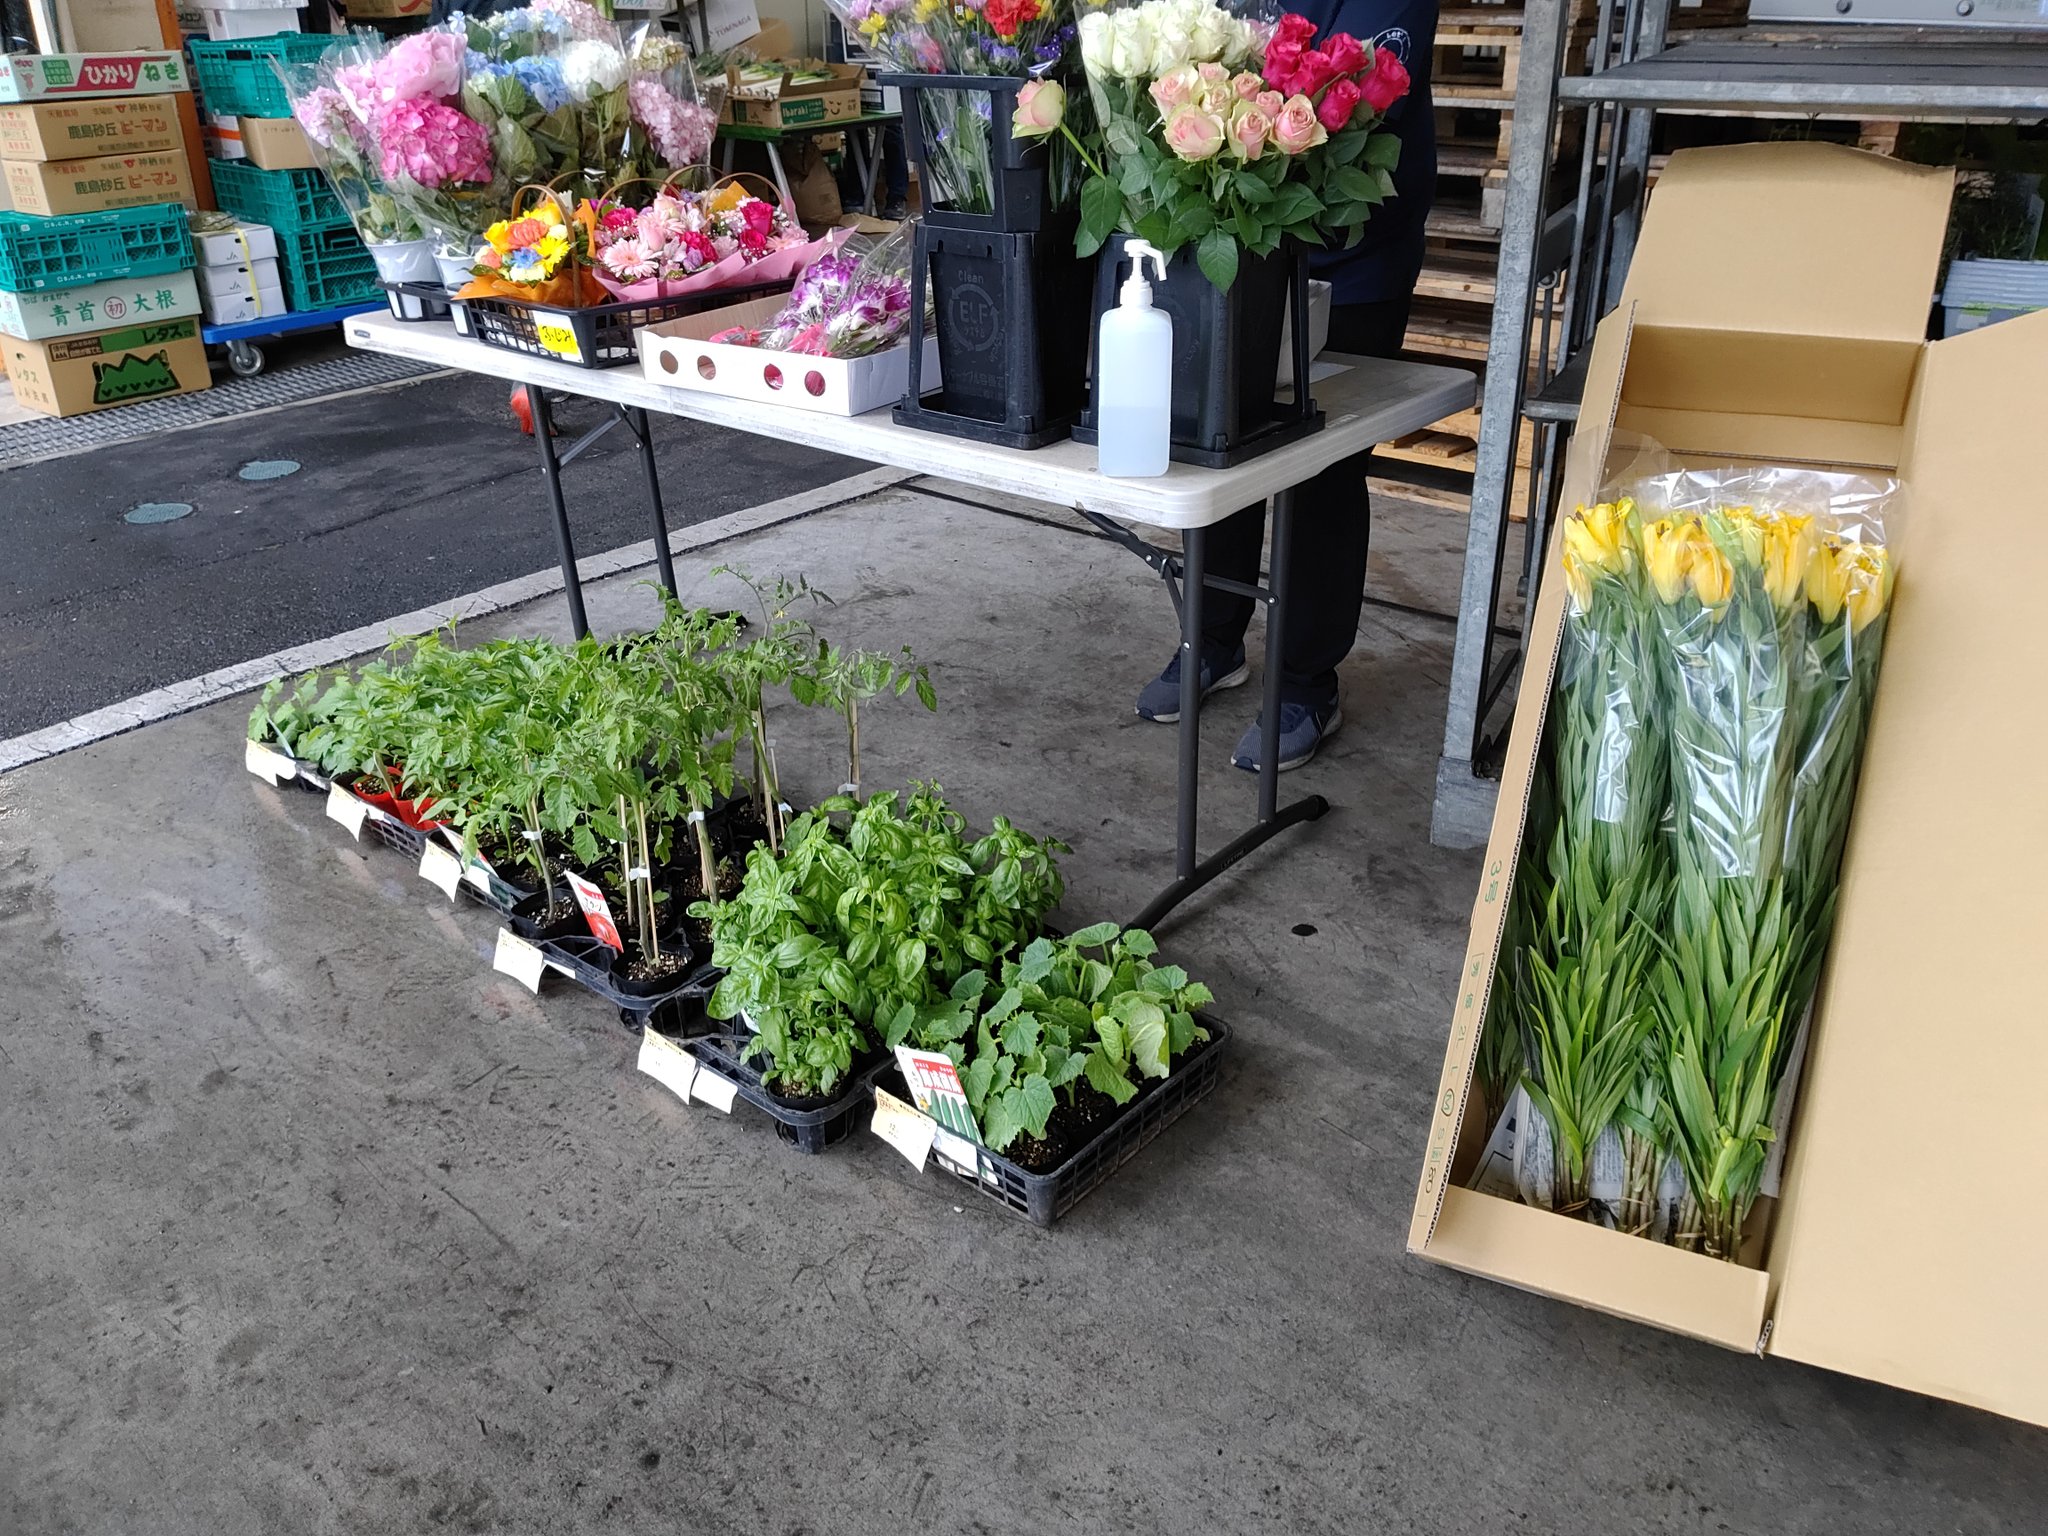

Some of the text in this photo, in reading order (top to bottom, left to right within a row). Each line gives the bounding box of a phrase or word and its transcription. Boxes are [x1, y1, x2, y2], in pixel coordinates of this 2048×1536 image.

[84, 64, 134, 85] ひかり
[144, 62, 179, 82] ねぎ
[67, 118, 168, 139] 鹿島砂丘 ピーマン
[75, 171, 178, 195] 鹿島砂丘 ピーマン
[958, 270, 983, 285] Clean
[50, 301, 96, 327] 青首
[107, 301, 123, 315] 初
[133, 289, 178, 313] 大根
[961, 300, 988, 325] ELF
[142, 324, 183, 344] レタス
[14, 366, 39, 384] レタス
[1485, 860, 1502, 903] 3号
